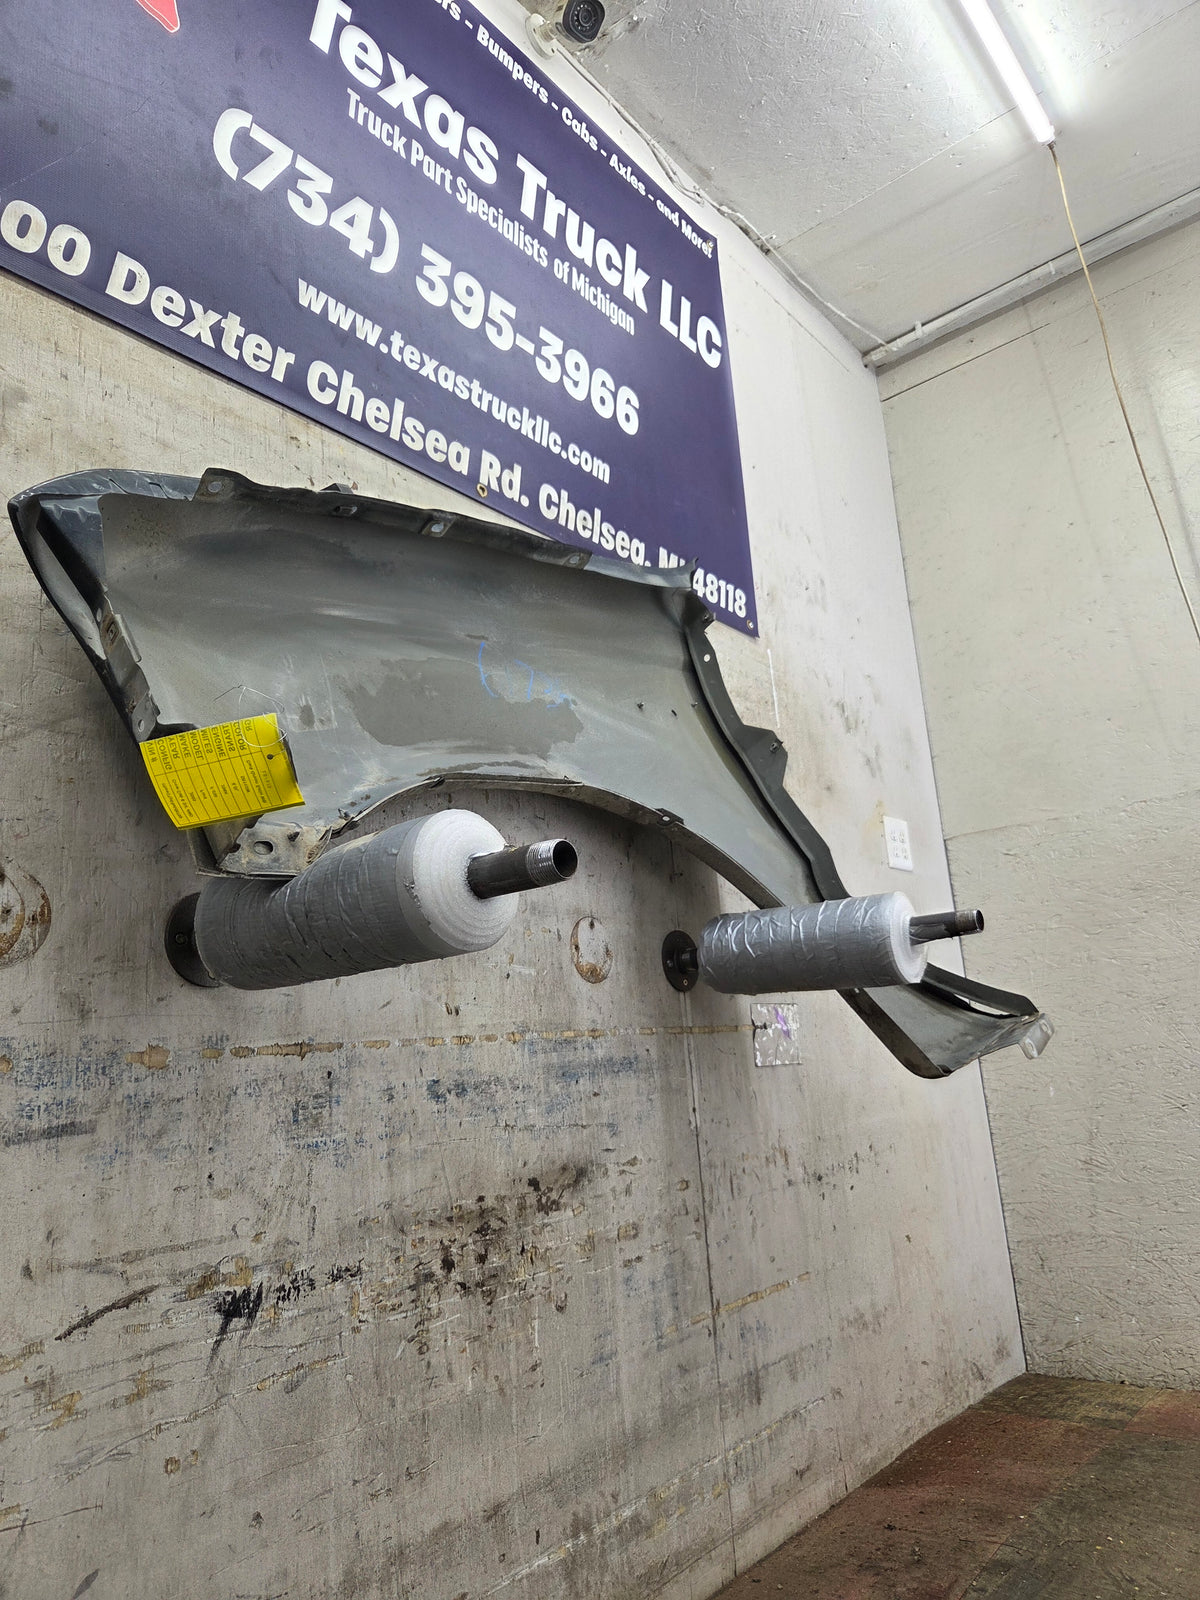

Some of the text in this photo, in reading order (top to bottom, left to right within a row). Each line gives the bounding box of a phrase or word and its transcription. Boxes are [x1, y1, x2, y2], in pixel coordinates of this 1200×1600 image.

[212, 107, 640, 437] (734) 395-3966
[309, 0, 723, 369] Texas Truck LLC
[346, 87, 636, 337] Truck Part Specialists of Michigan
[434, 0, 461, 21] rs
[476, 23, 549, 104] Bumpers
[561, 106, 598, 152] Cabs
[608, 153, 646, 196] Axles
[656, 199, 680, 228] and
[681, 218, 714, 260] More!
[104, 251, 296, 384] Dexter
[306, 359, 471, 476] Chelsea
[479, 448, 530, 508] Rd.
[658, 546, 686, 569] M
[692, 567, 747, 619] 48118
[298, 277, 611, 486] www.texastruckllc.com
